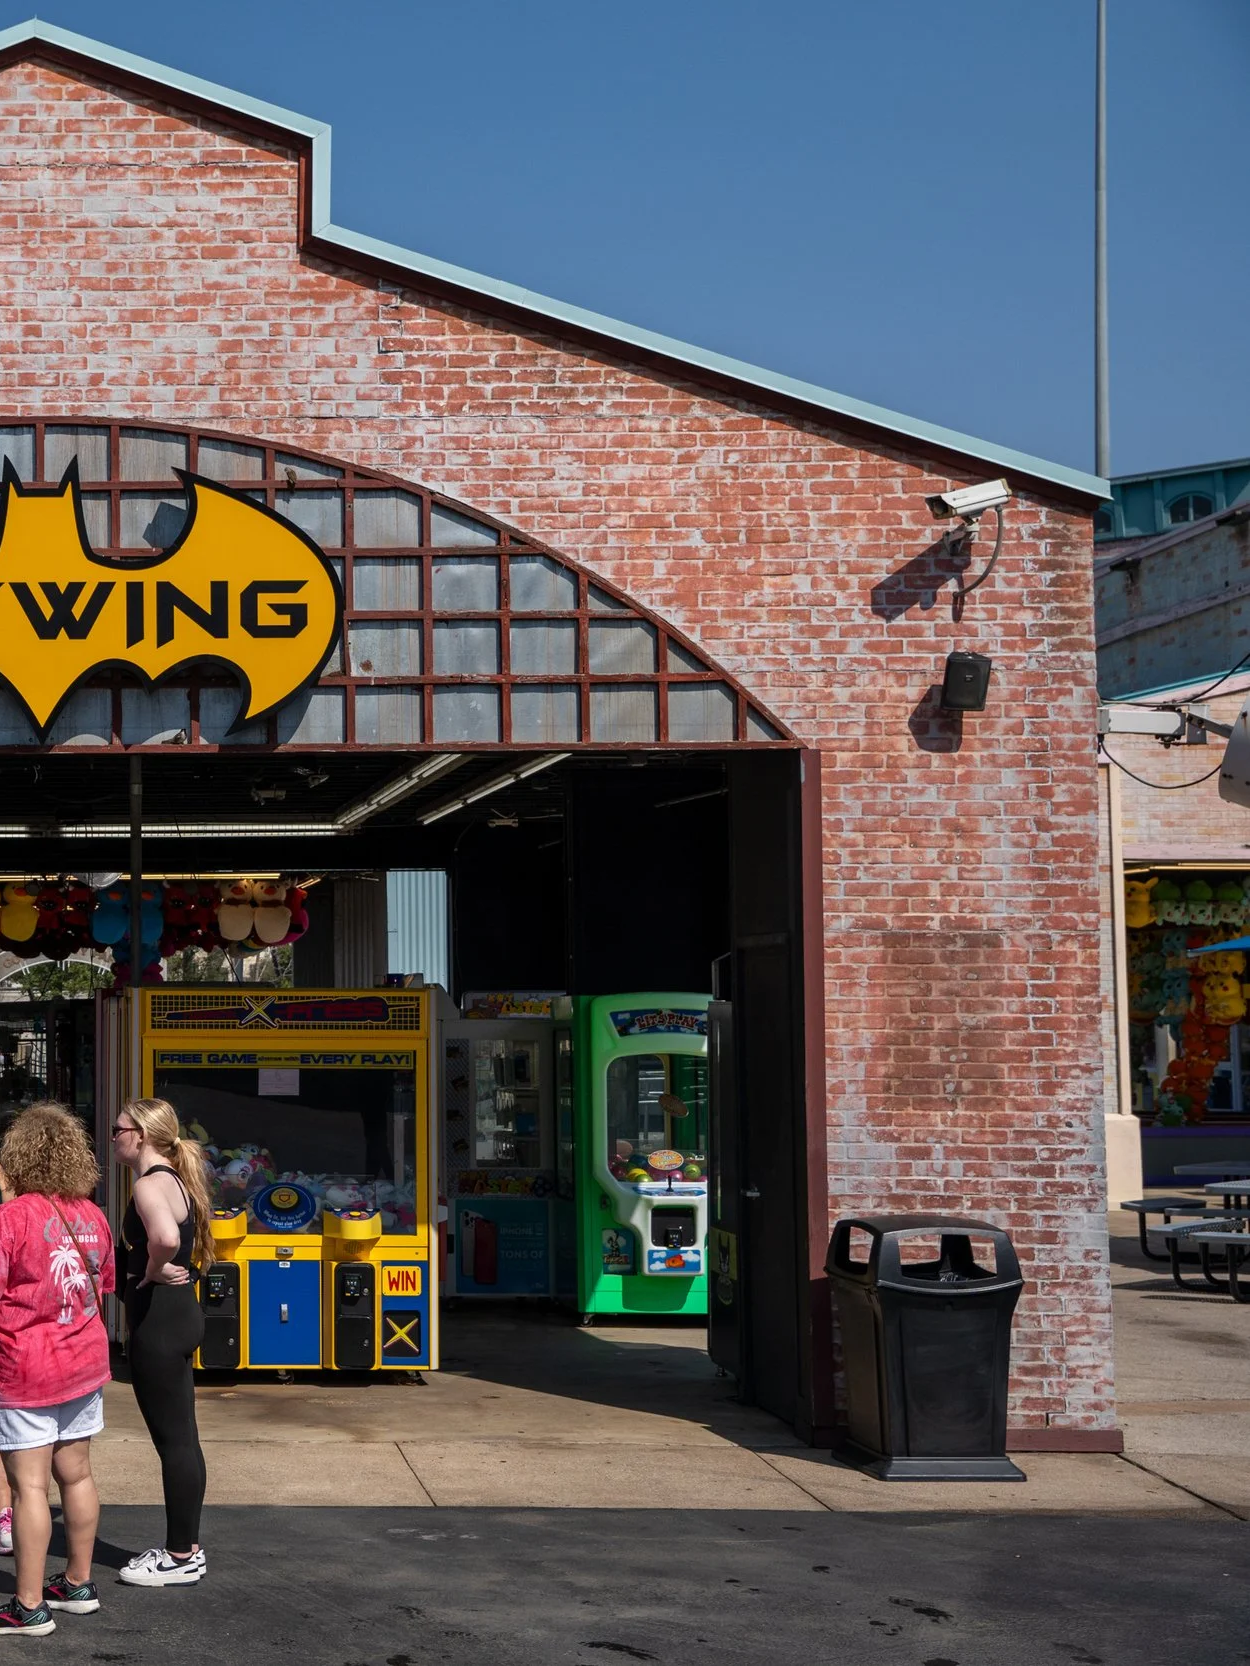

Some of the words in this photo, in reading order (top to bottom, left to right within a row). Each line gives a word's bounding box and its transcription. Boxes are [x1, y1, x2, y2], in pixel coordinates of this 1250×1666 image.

[160, 1054, 204, 1064] FREE
[207, 1054, 257, 1064] GAME
[300, 1054, 355, 1064] EVERY
[361, 1054, 410, 1064] PLAY!
[388, 1270, 416, 1291] WIN
